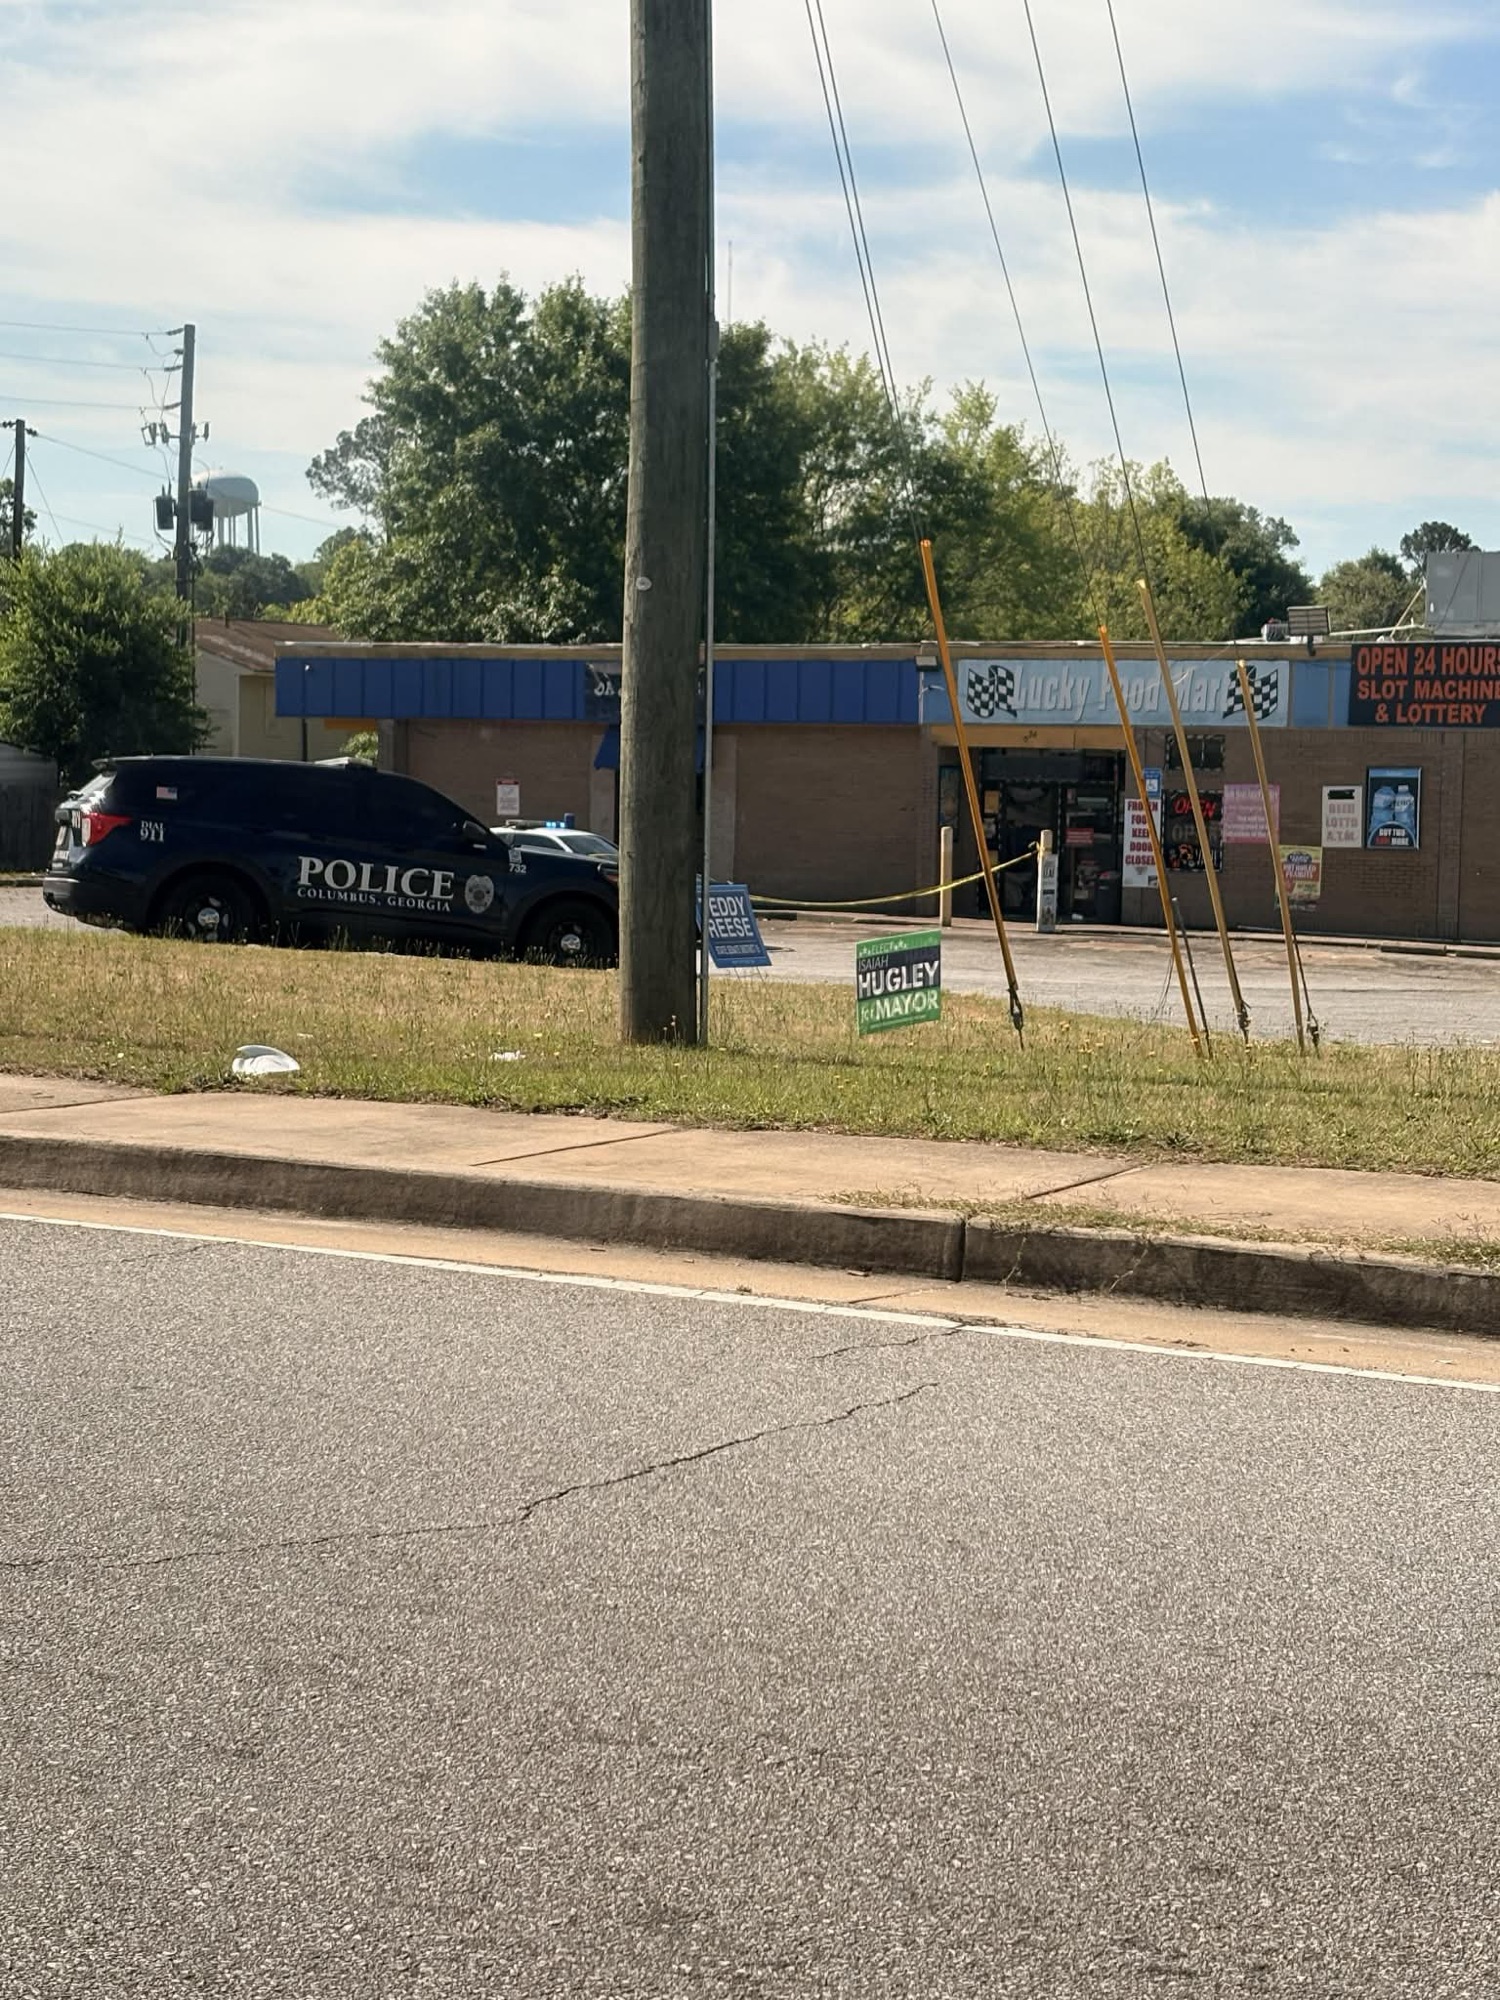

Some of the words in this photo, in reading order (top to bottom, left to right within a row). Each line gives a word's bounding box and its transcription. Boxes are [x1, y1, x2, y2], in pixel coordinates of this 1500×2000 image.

[1357, 647, 1408, 675] OPEN
[1414, 647, 1436, 675] 24
[1012, 664, 1091, 721] Lucky
[1358, 679, 1408, 700] SLOT
[1375, 703, 1389, 723] &
[1396, 703, 1486, 724] LOTTERY
[1131, 814, 1147, 824] FOO
[140, 827, 164, 842] 911
[297, 855, 455, 900] POLICE
[509, 863, 527, 873] 732
[387, 897, 450, 912] GEORGIA
[699, 896, 745, 917] EDDY
[708, 918, 753, 938] REESE
[858, 955, 889, 971] ISAIAH
[858, 960, 939, 999] HUGLEY
[876, 989, 938, 1020] MAYOR
